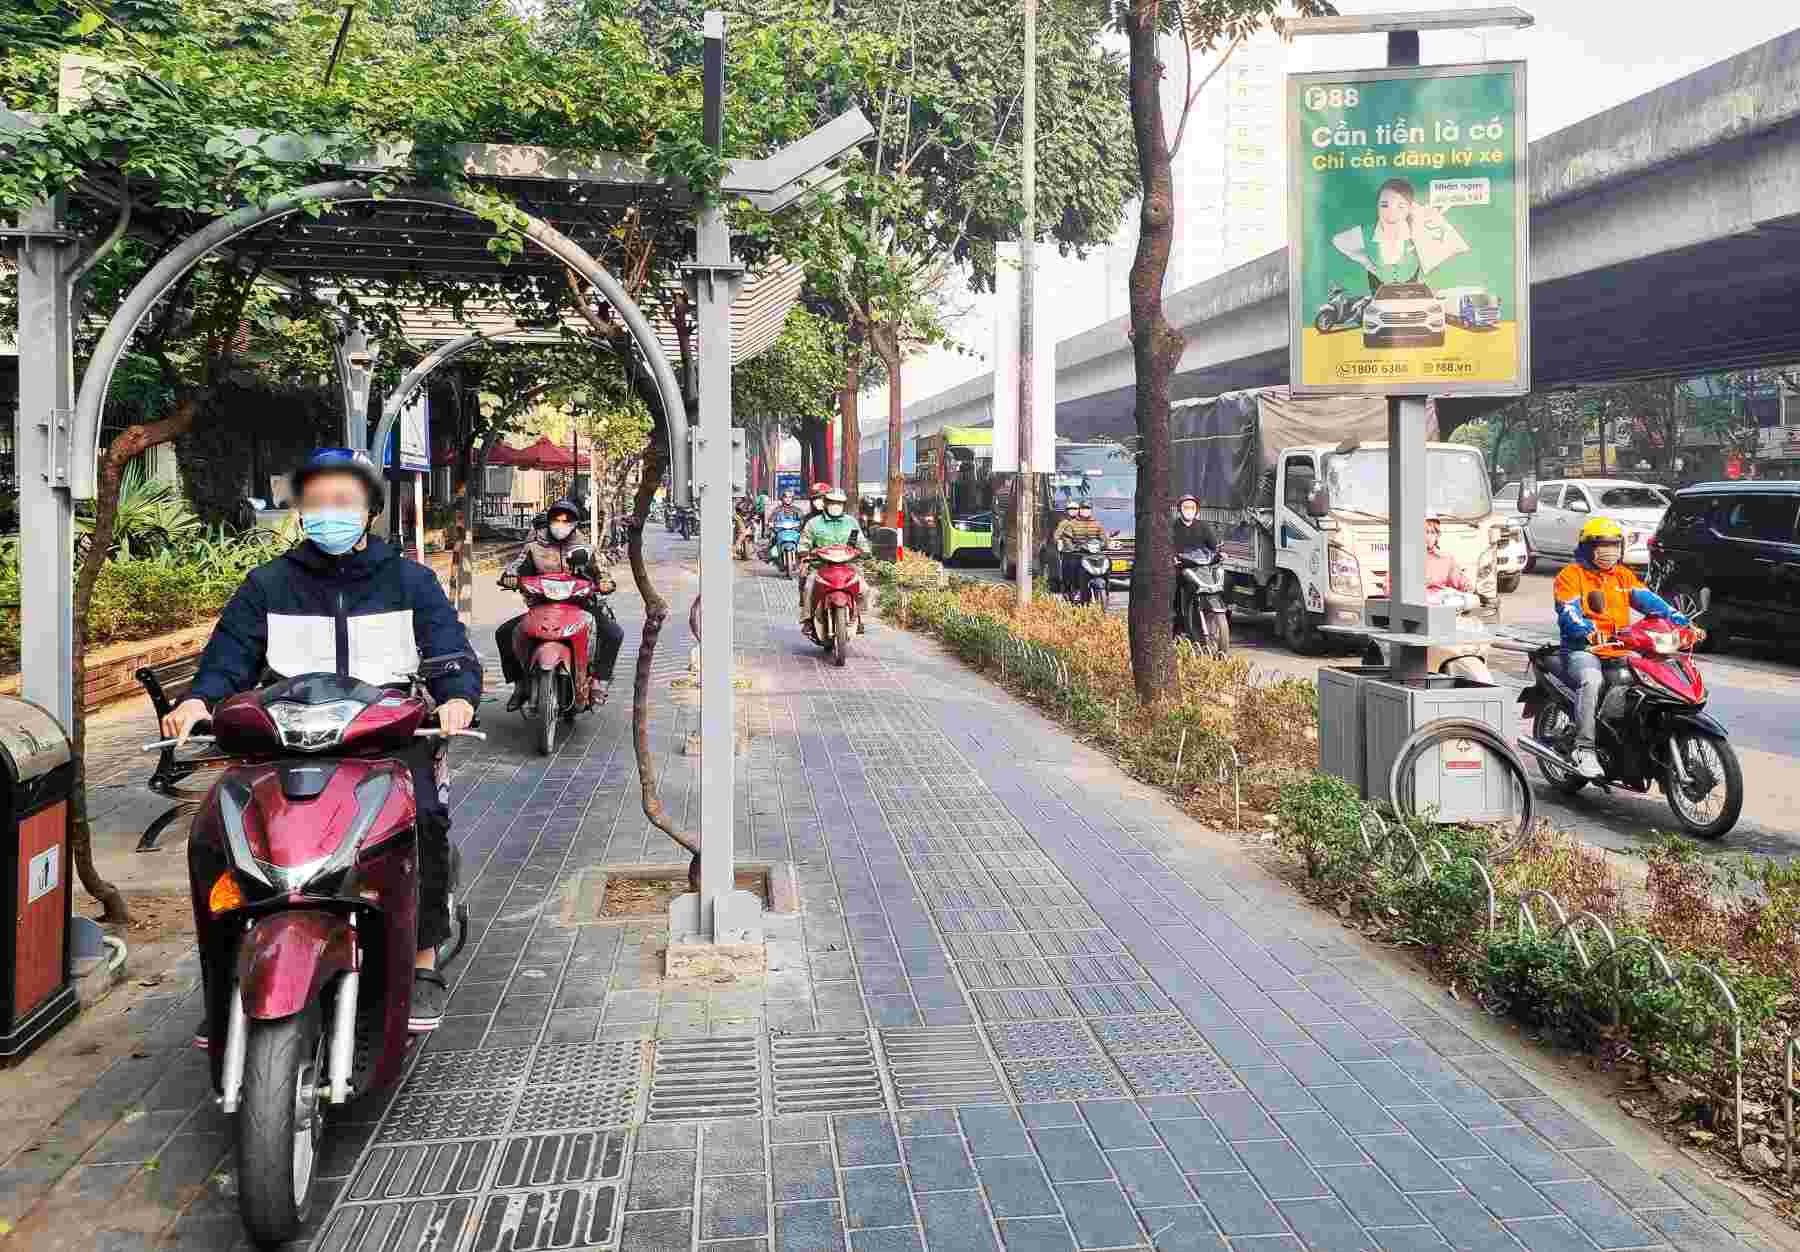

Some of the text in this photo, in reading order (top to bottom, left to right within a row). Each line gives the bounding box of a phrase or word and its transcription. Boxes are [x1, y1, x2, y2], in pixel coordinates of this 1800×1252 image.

[1312, 115, 1503, 147] Cần tiền là có
